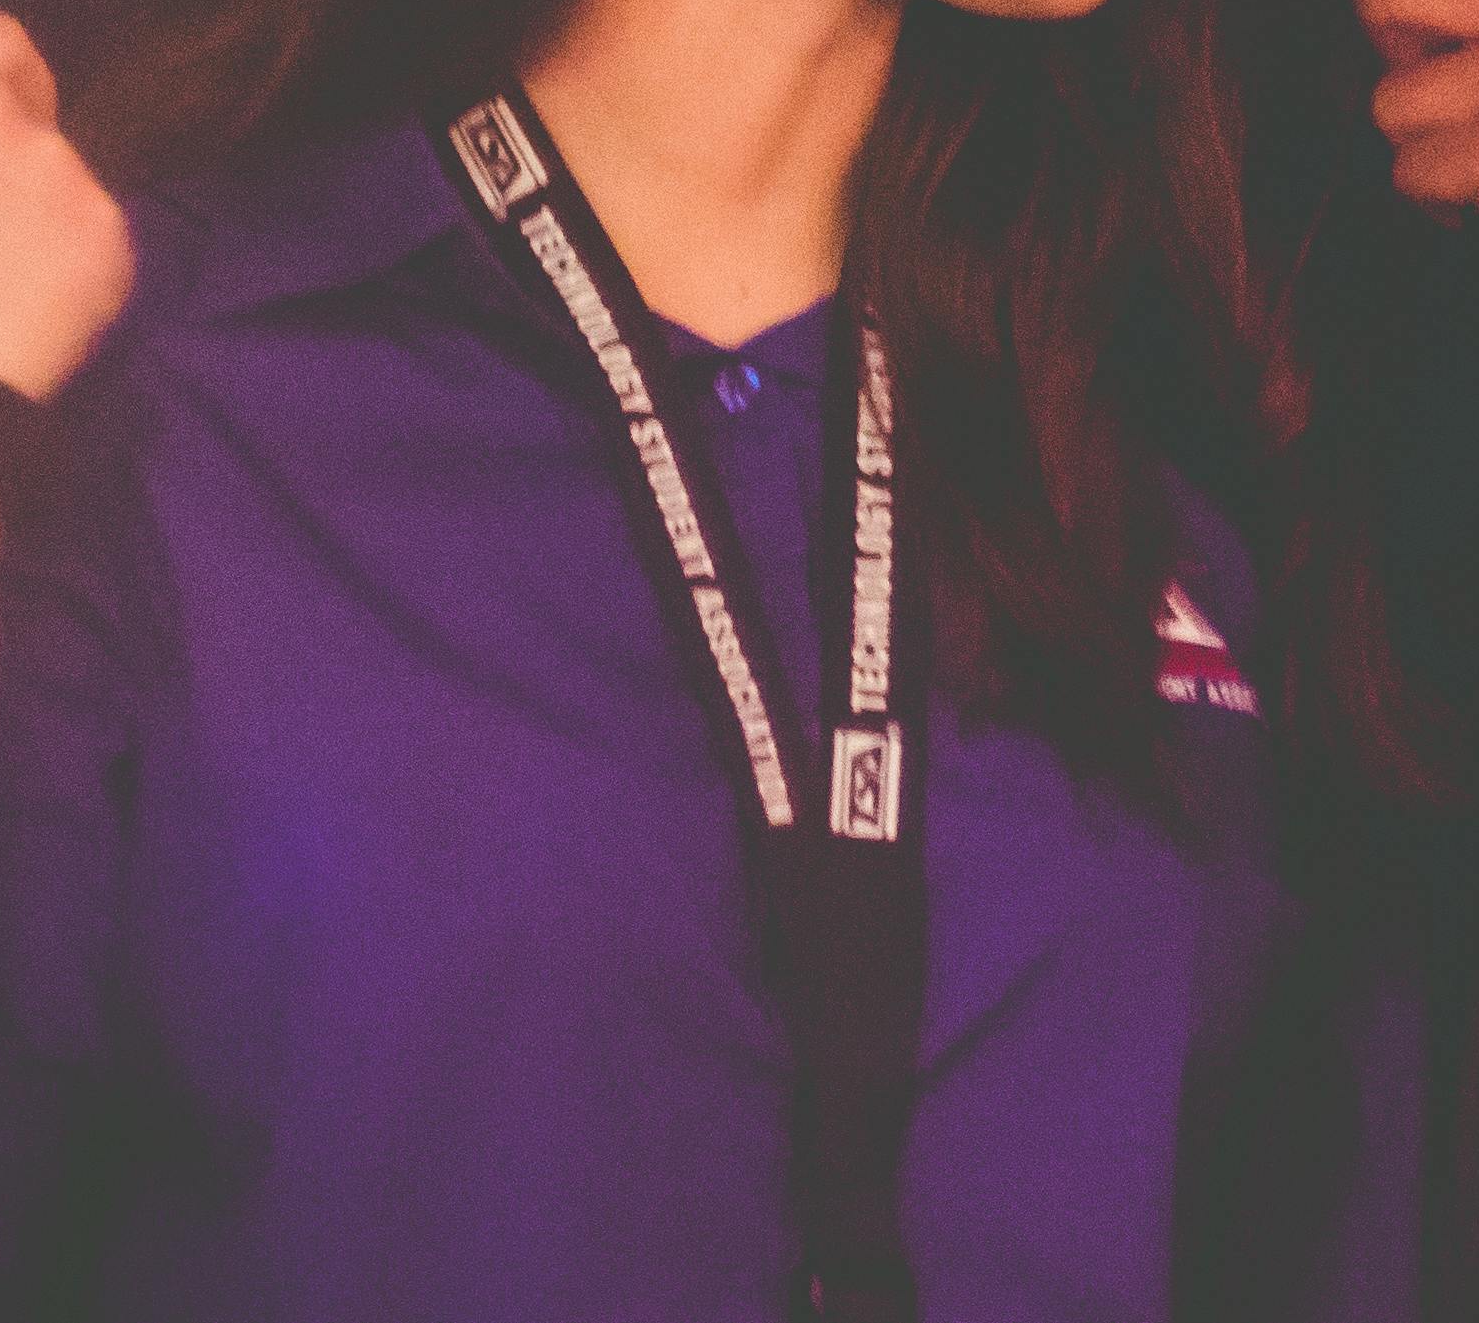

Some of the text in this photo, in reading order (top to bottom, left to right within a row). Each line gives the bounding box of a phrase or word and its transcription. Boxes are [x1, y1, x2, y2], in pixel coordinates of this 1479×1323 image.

[521, 204, 654, 414] TECHNOLOGY
[631, 418, 715, 580] STUDENT
[851, 481, 894, 713] TECHNOLOGY
